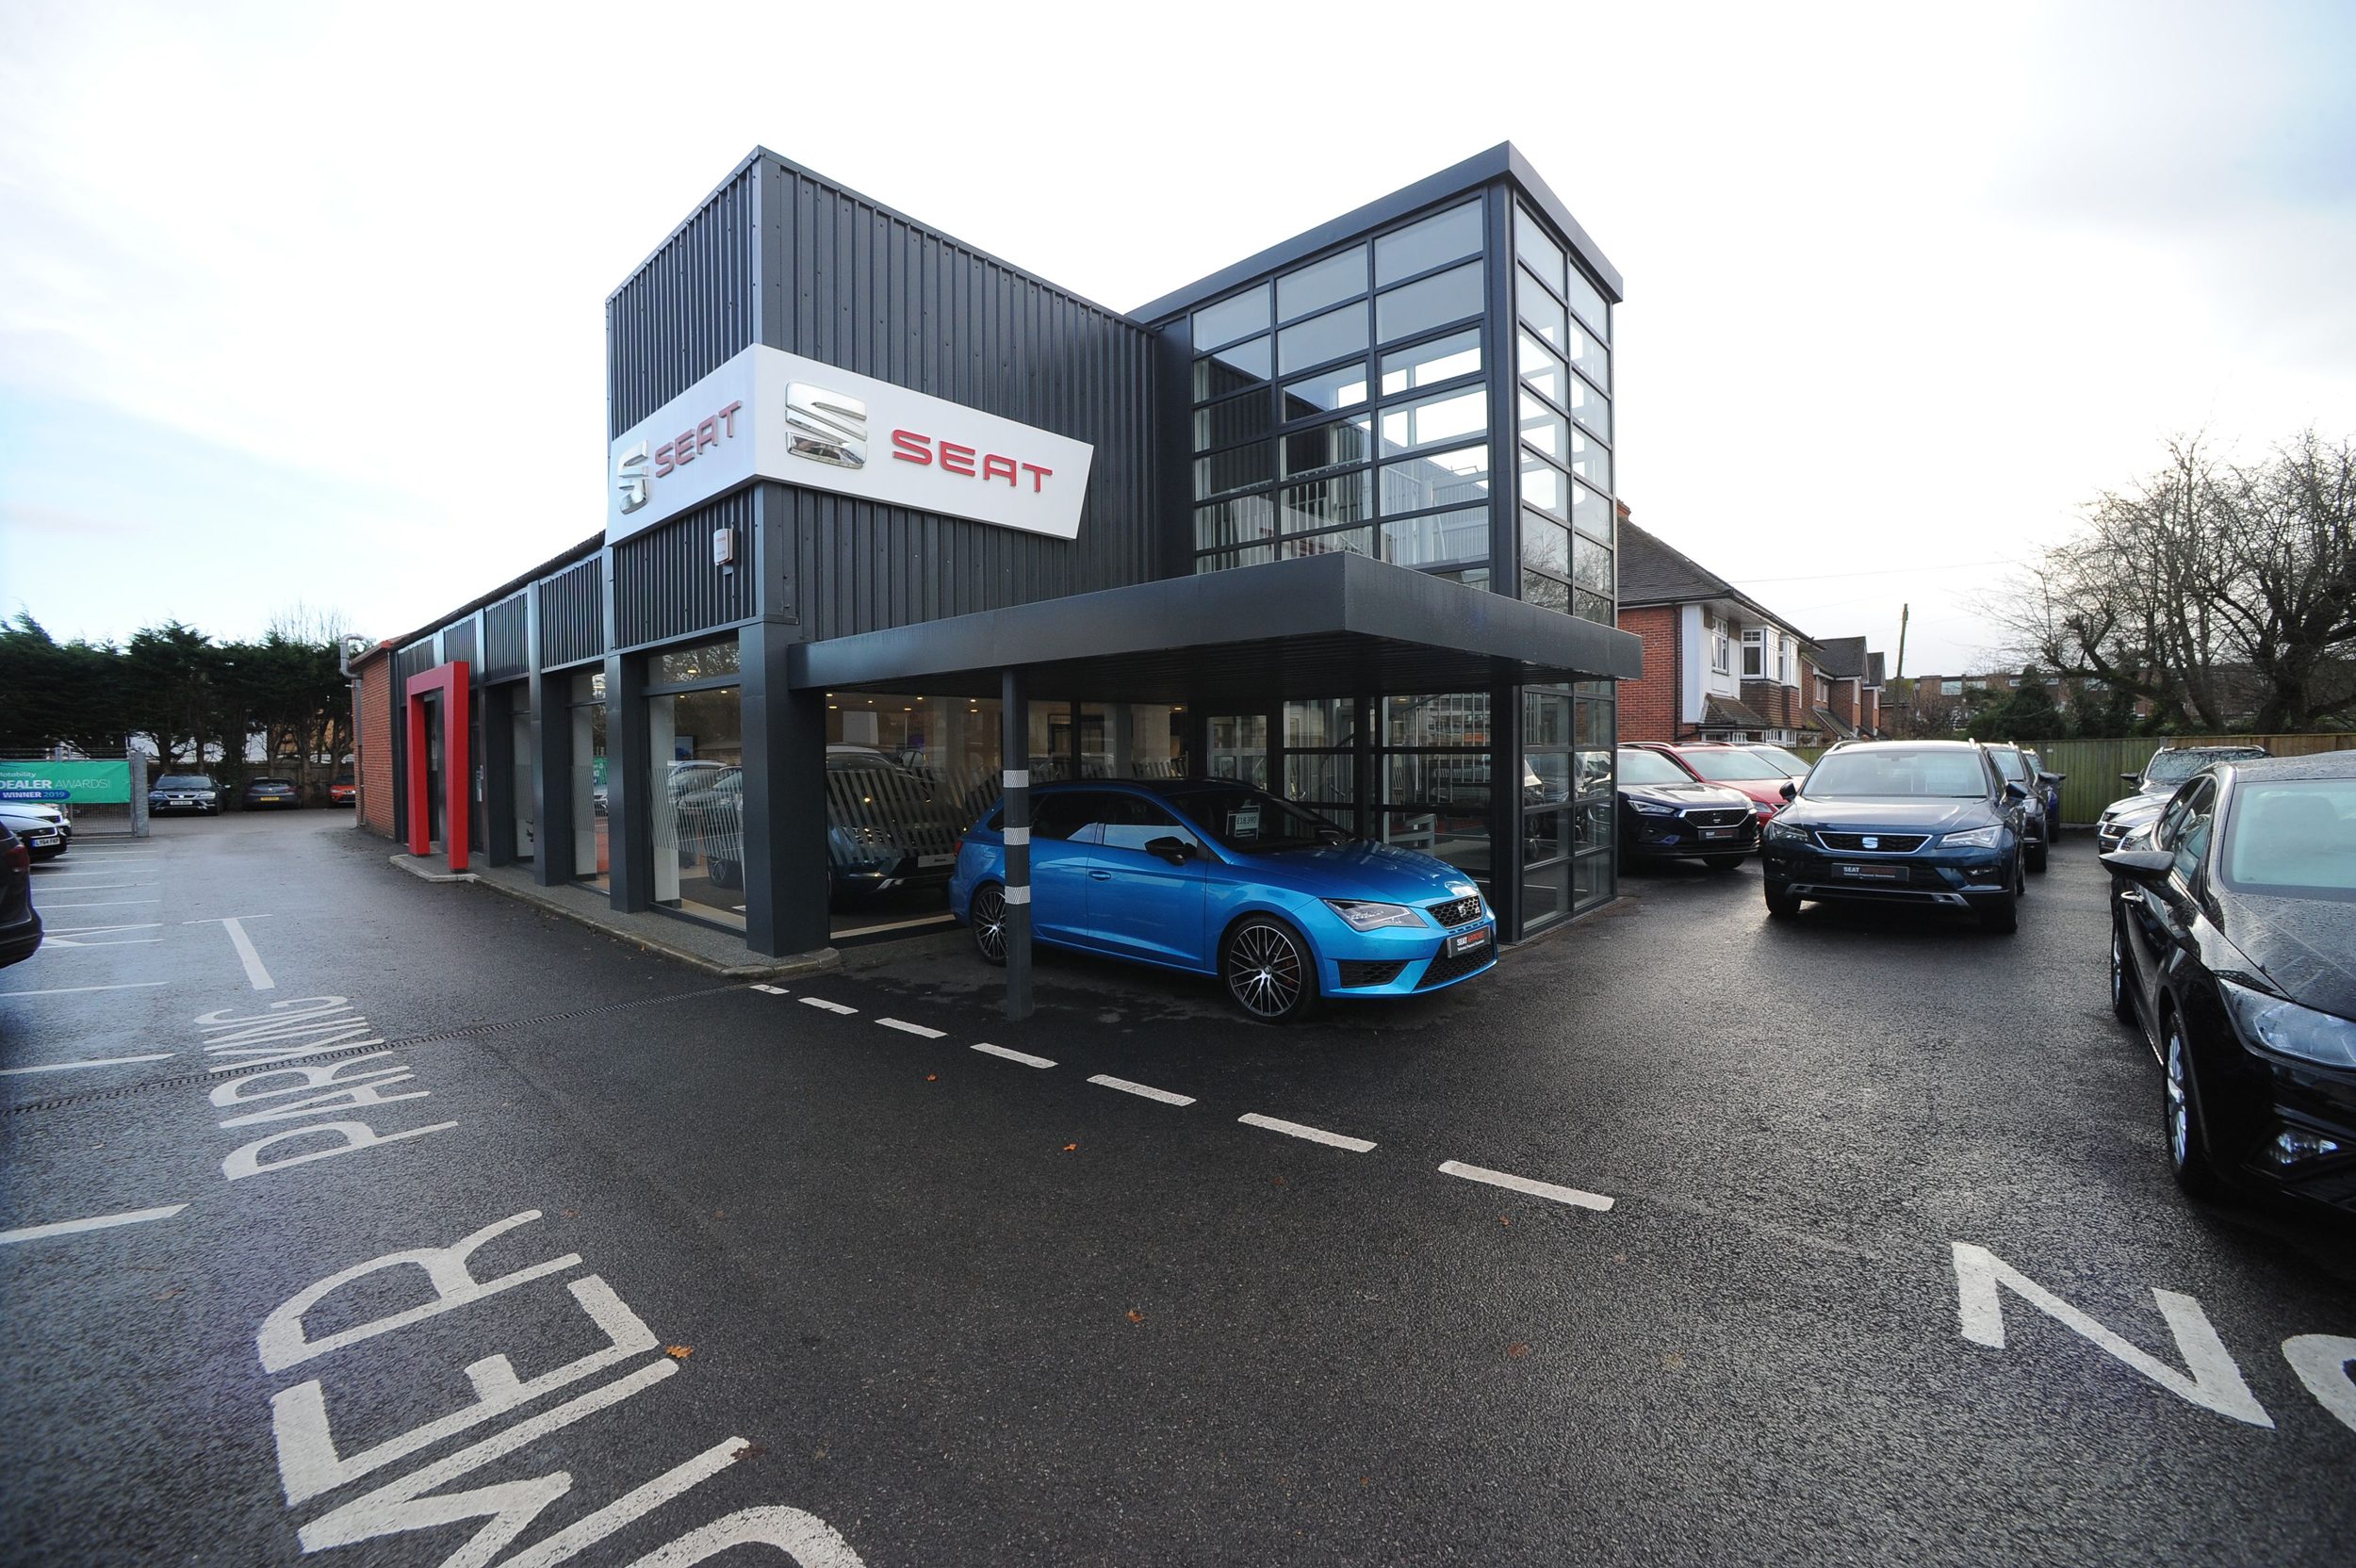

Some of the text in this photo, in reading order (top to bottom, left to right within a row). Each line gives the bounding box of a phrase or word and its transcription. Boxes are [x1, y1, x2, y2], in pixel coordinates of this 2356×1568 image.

[655, 399, 743, 479] SEAT
[891, 428, 1054, 494] SEAT
[0, 779, 53, 790] DEALER
[1456, 937, 1467, 946] SEAT
[195, 995, 459, 1181] PARKING
